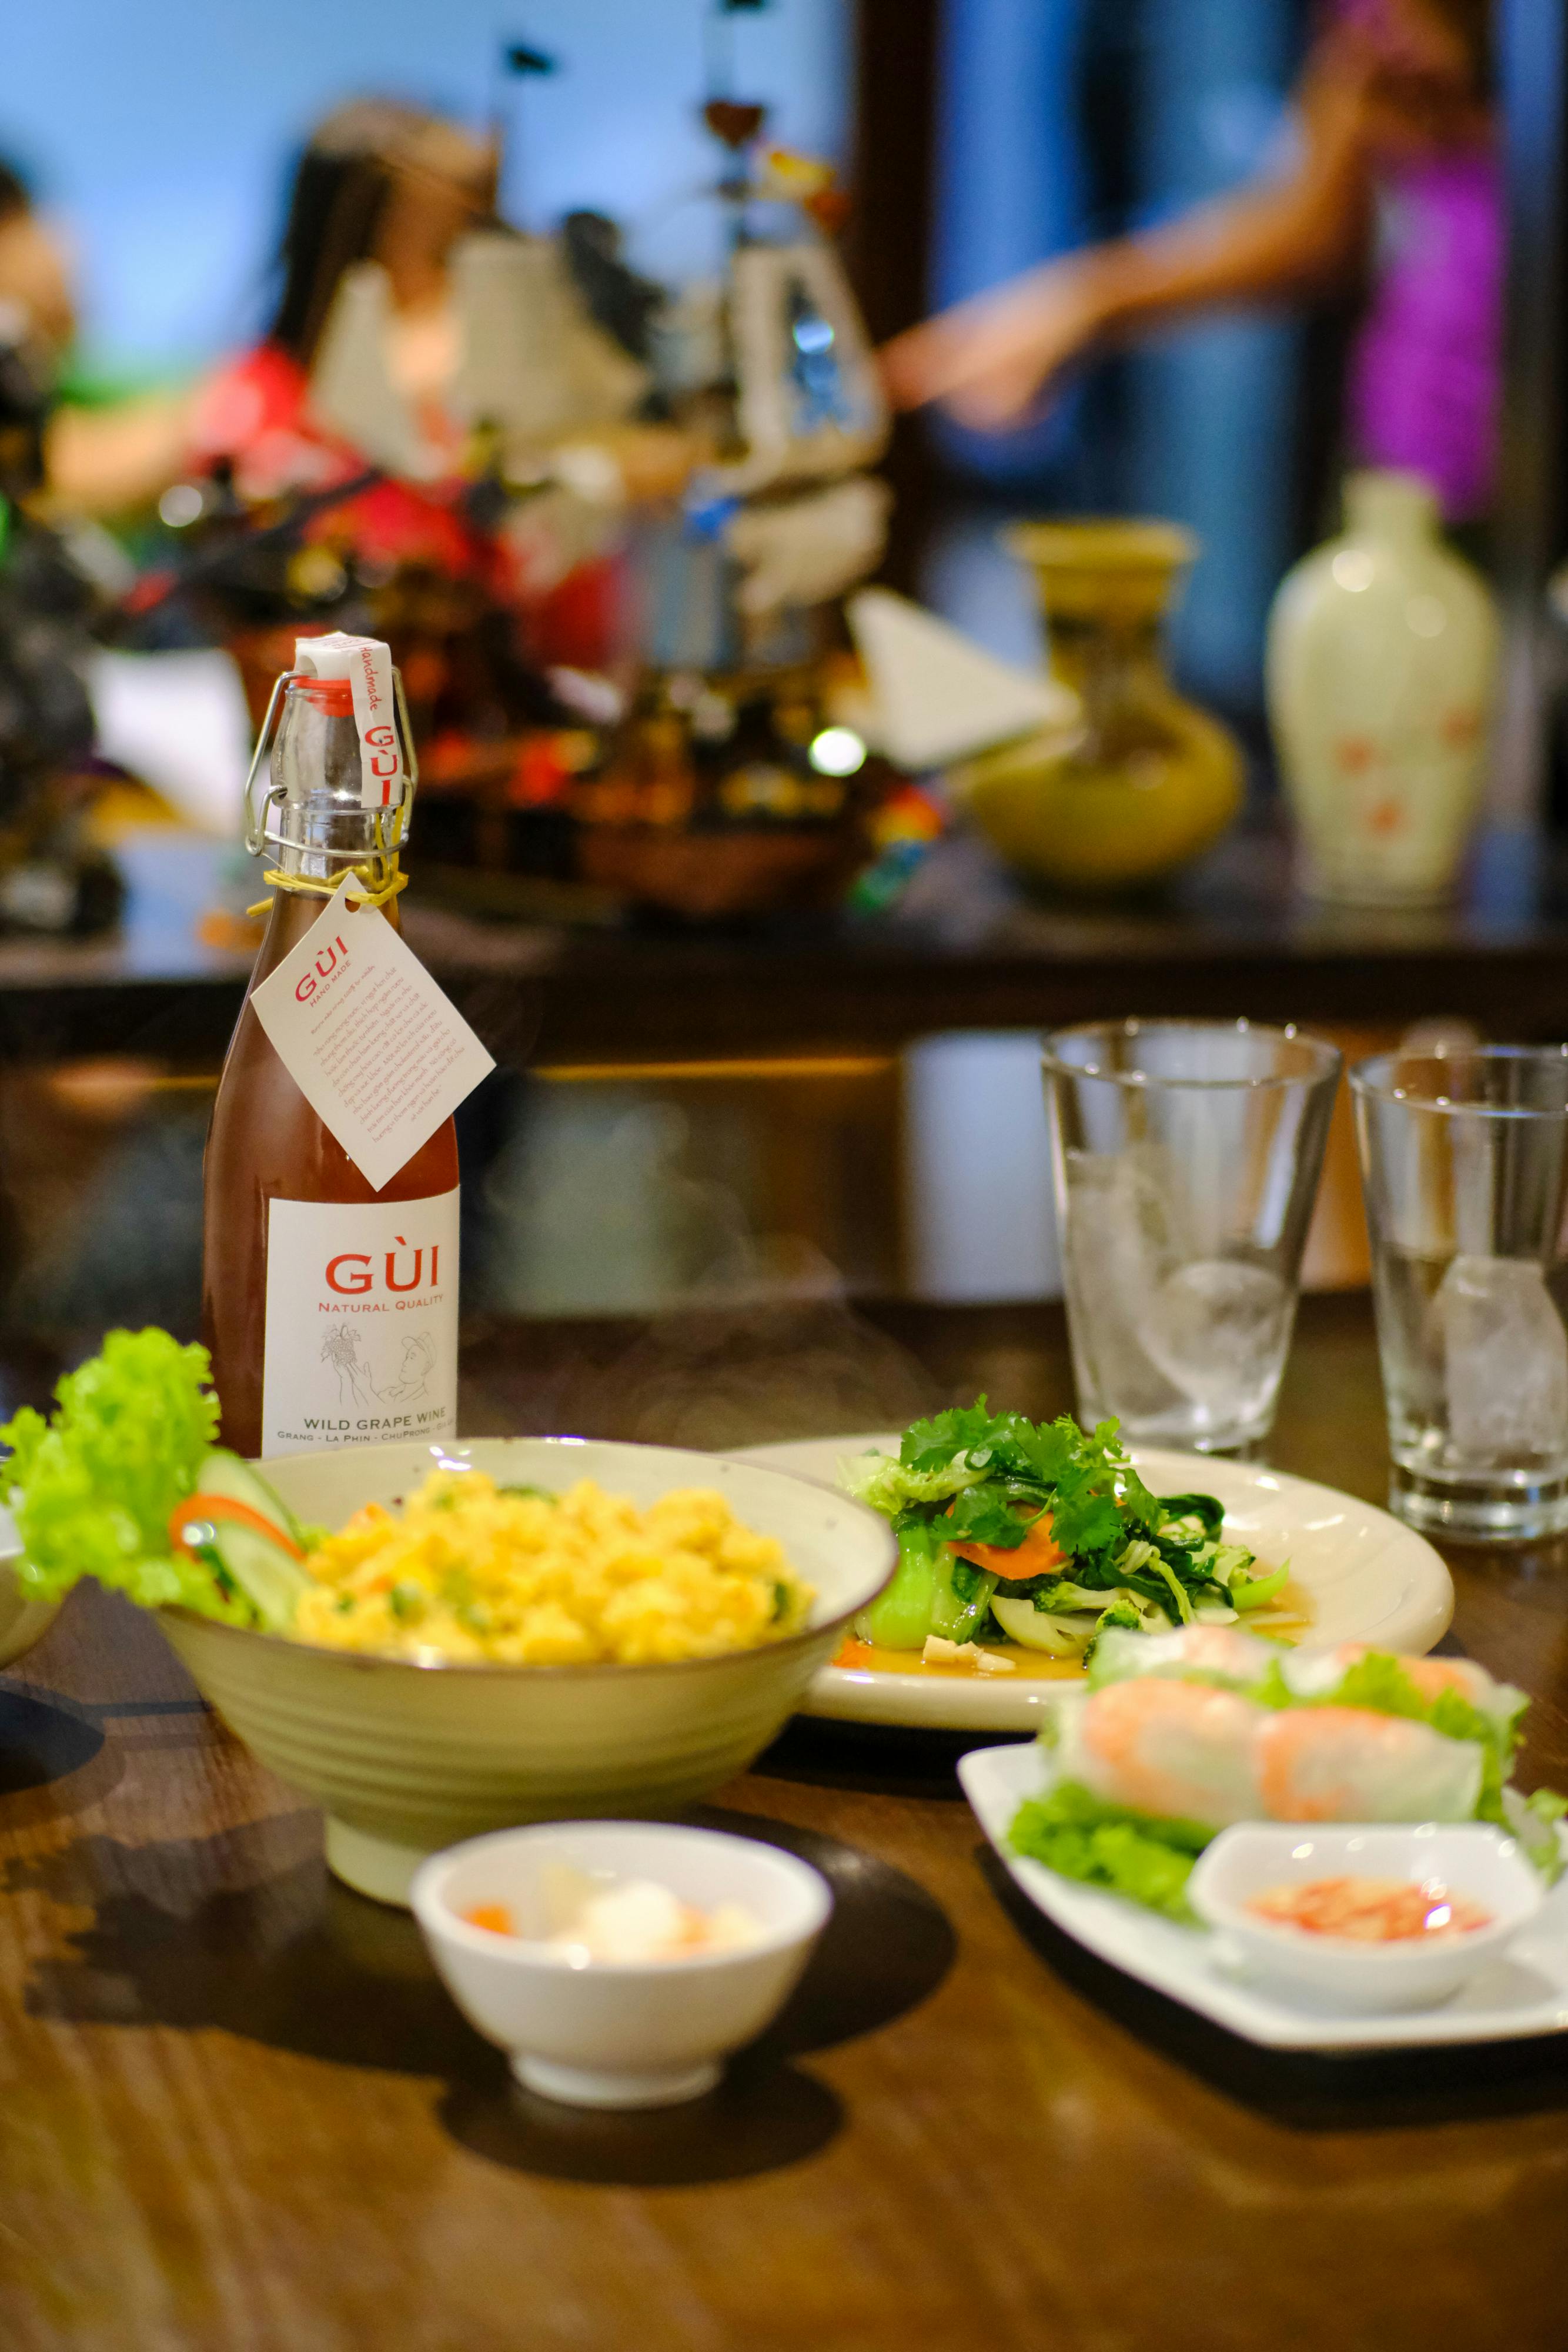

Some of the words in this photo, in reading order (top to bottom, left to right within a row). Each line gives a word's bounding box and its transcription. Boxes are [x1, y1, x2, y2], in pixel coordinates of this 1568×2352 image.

[359, 647, 382, 711] Handmade
[365, 726, 397, 806] GÙI
[295, 936, 348, 1001] GÙI
[310, 984, 330, 1007] HAND
[331, 960, 351, 983] MADE
[325, 1236, 439, 1295] GÙI
[319, 1302, 390, 1312] NATURAL
[395, 1295, 443, 1310] QUALITY
[304, 1418, 350, 1430] WILD
[356, 1416, 411, 1430] GRAPE
[417, 1407, 446, 1424] WINE
